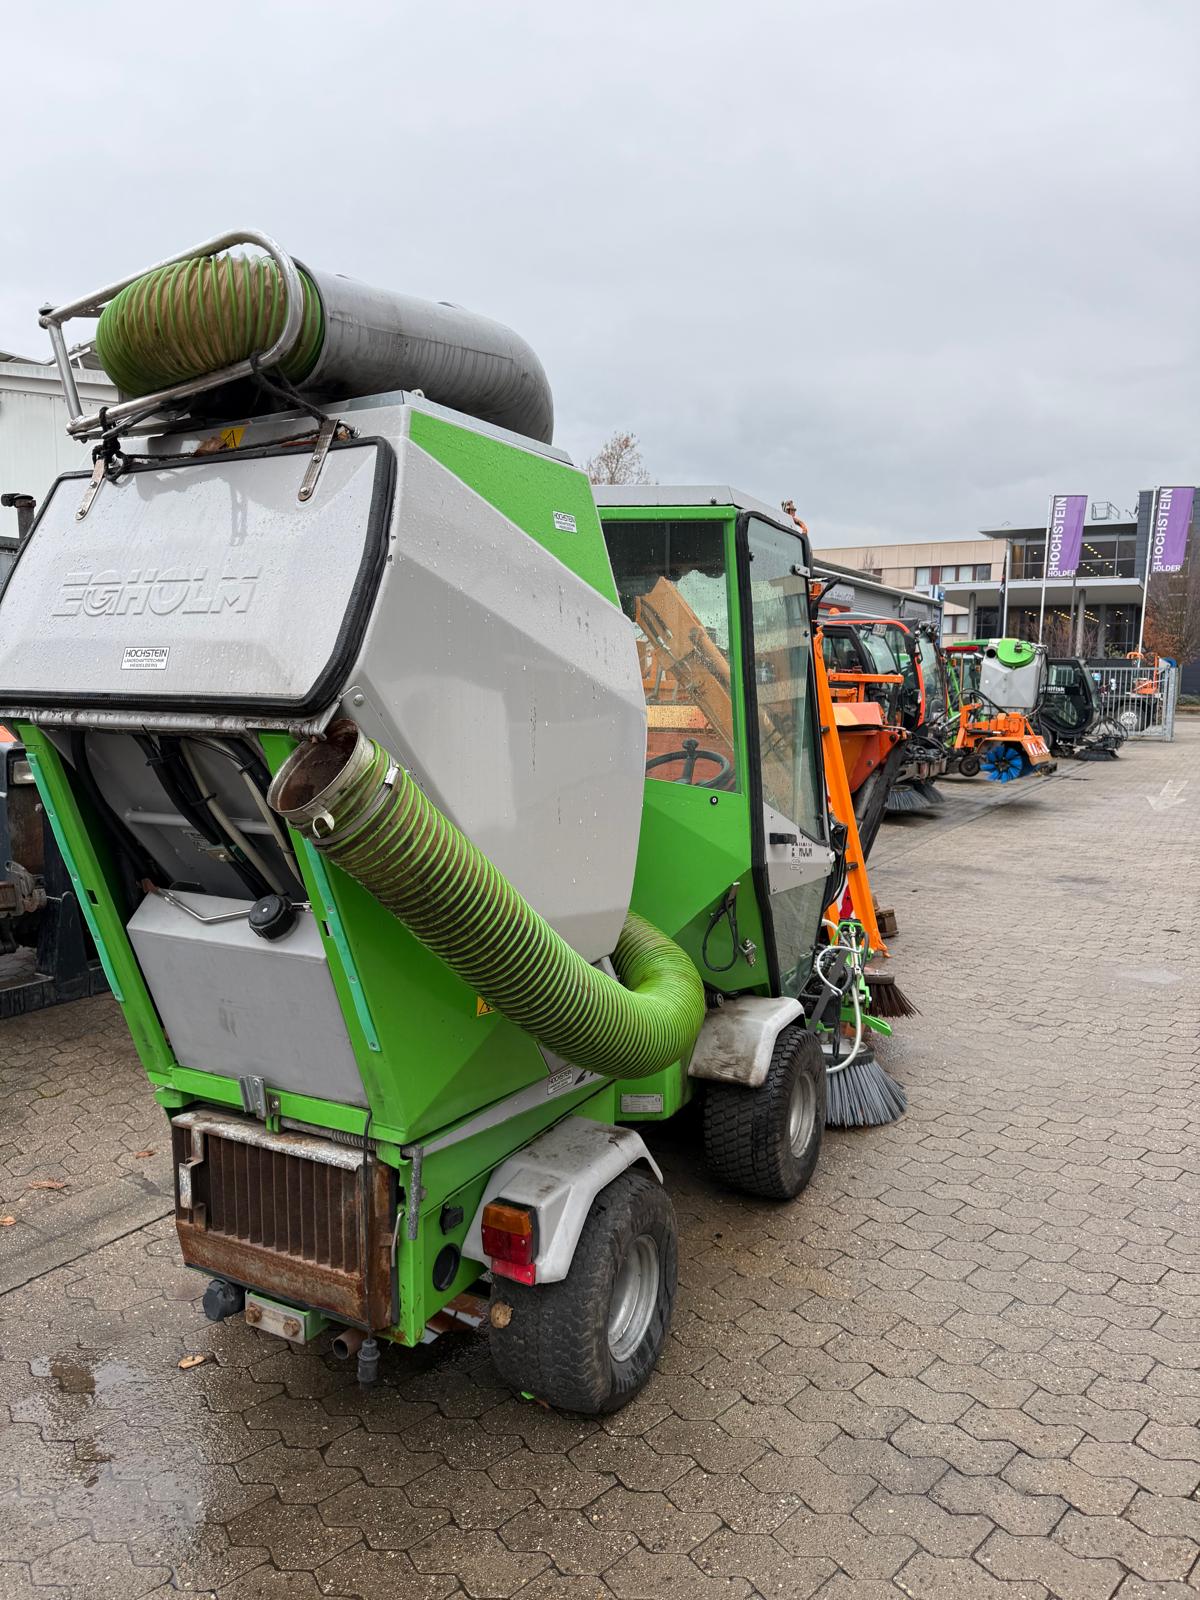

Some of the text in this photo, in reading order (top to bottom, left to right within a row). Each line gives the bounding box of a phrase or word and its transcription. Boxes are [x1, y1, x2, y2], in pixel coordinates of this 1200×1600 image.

[1049, 497, 1067, 571] HOCHSTEIN
[1154, 488, 1173, 567] HOCHSTEIN
[52, 566, 262, 617] EGHOLM
[125, 649, 168, 658] HOCHSTEIN
